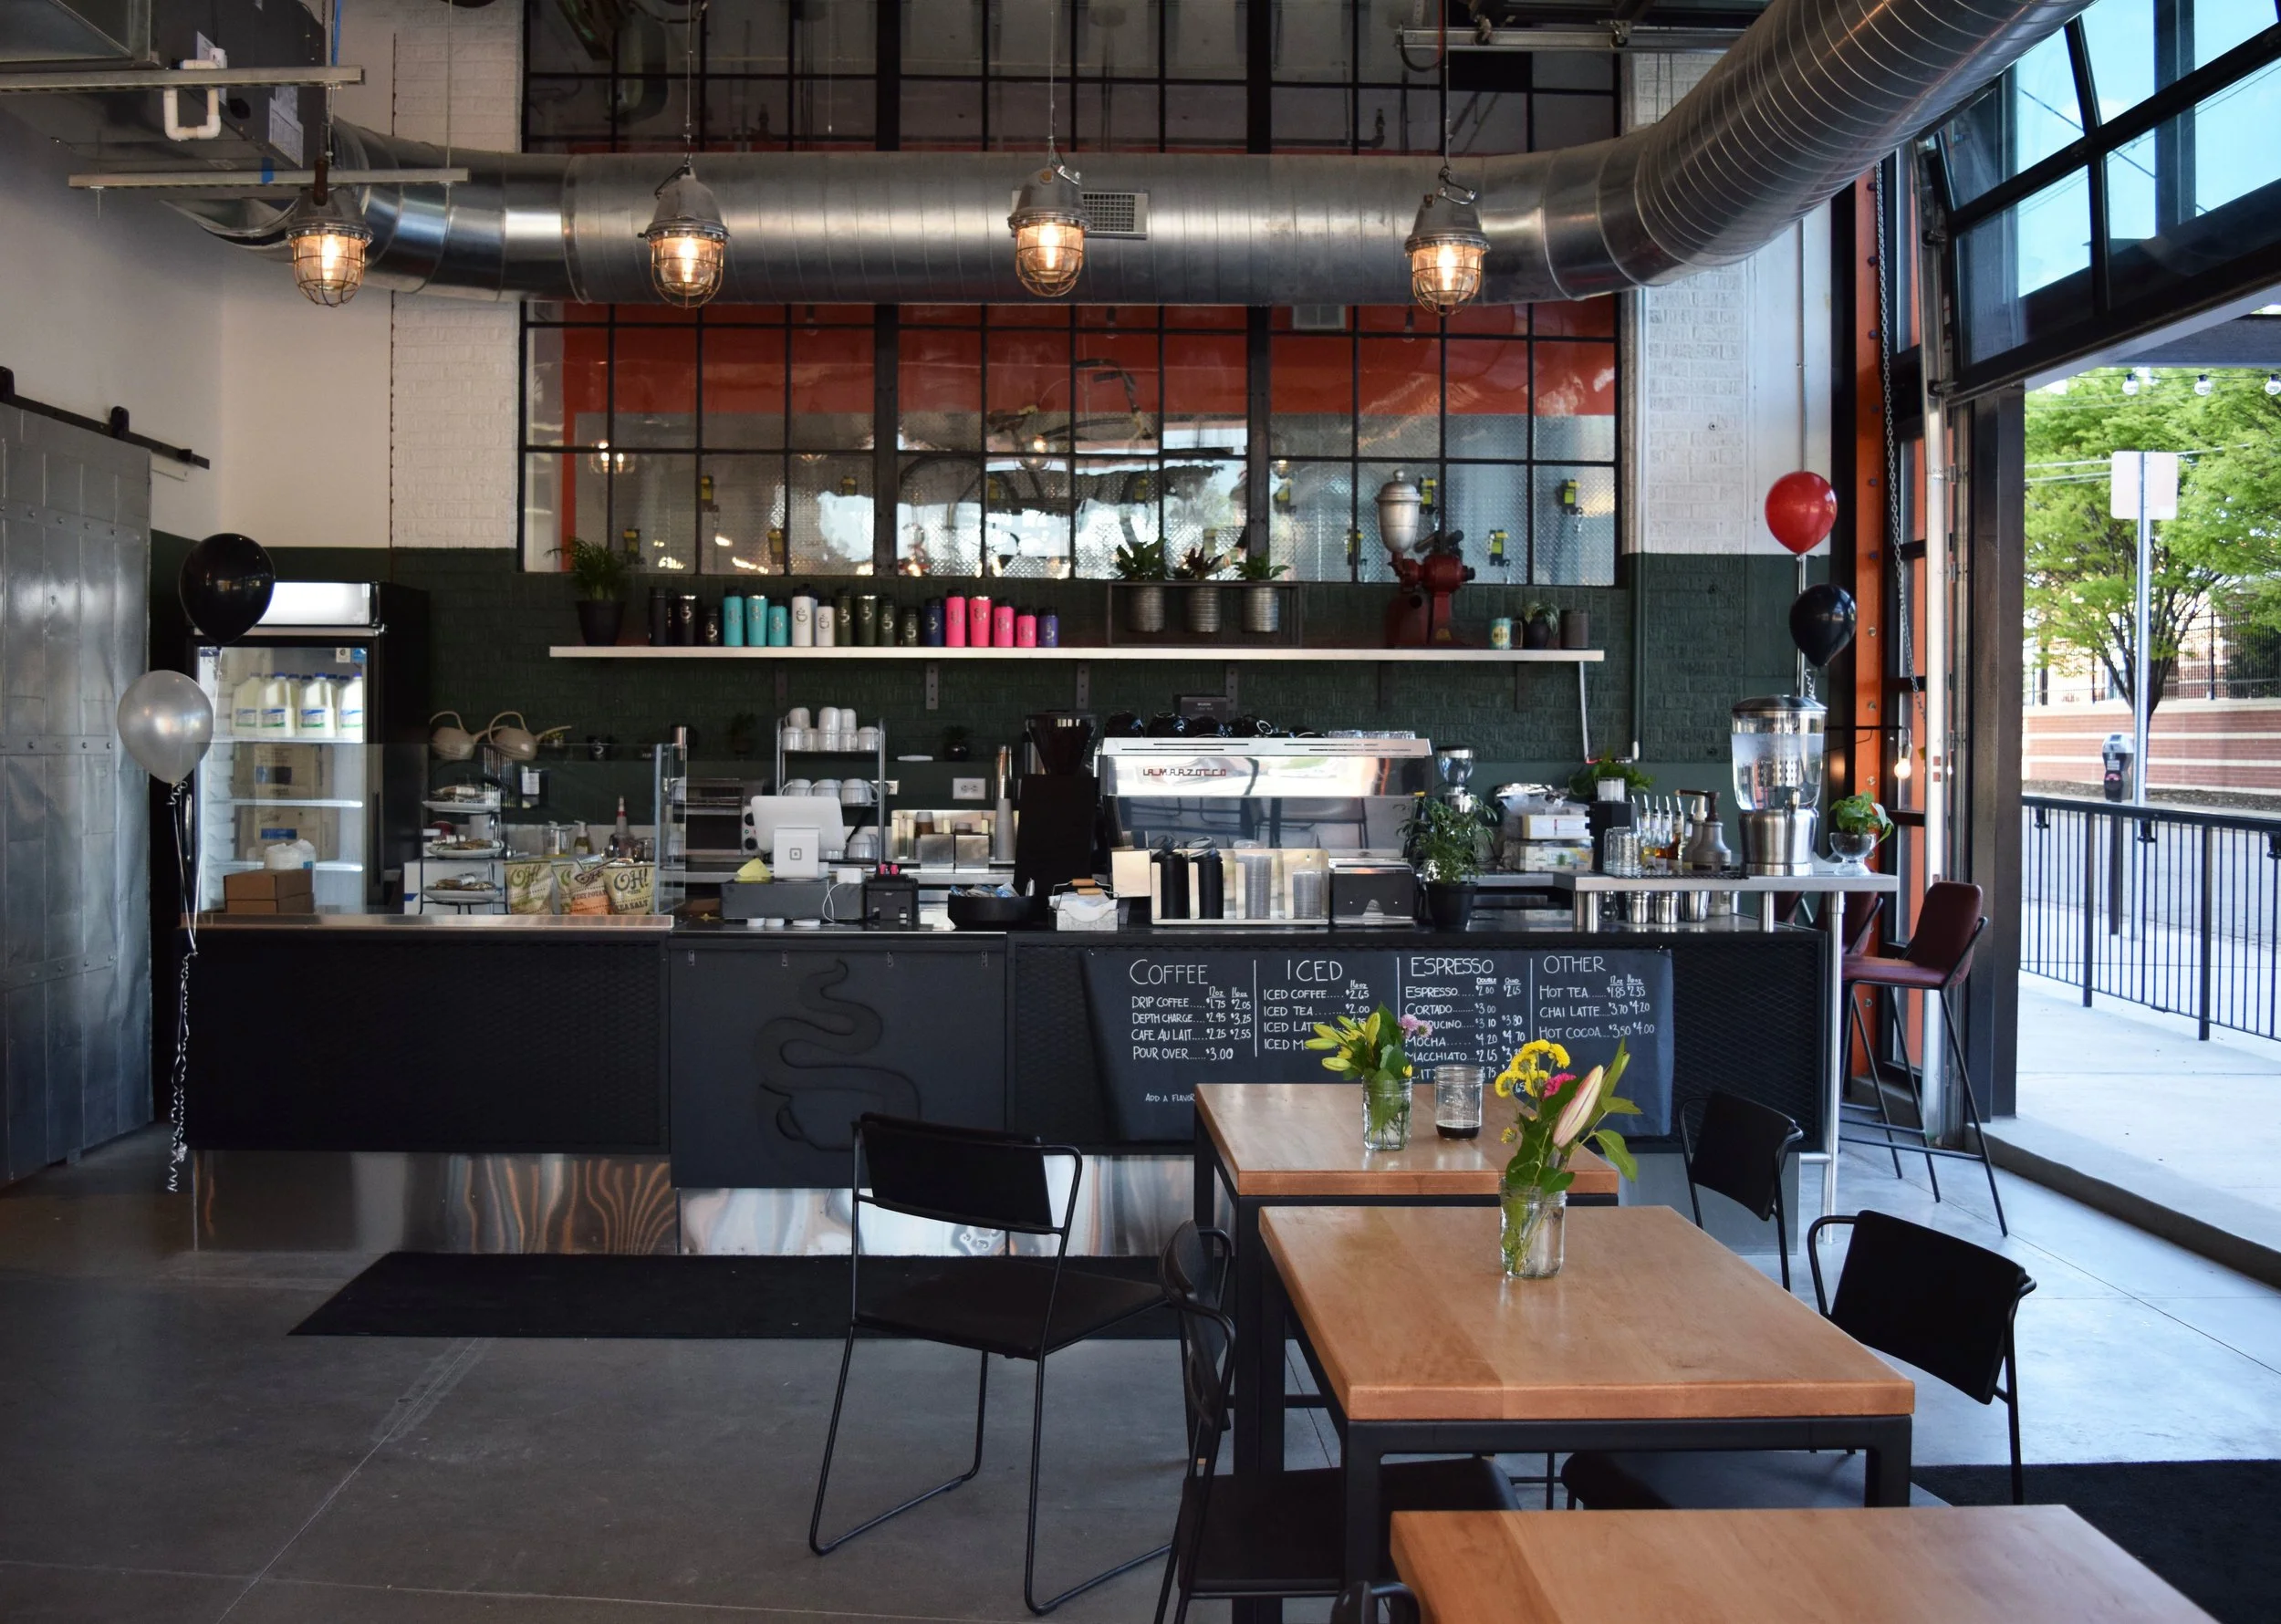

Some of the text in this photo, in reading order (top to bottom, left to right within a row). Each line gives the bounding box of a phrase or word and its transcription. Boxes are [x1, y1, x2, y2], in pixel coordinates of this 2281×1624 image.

[613, 868, 649, 891] OH!
[1411, 957, 1495, 976] ESPRESSO
[1543, 955, 1606, 973] OTHER
[1130, 959, 1208, 984] COFFEE
[1287, 960, 1343, 981] ICED
[1263, 989, 1288, 1000] ICED
[1539, 985, 1564, 1000] HOT
[1131, 996, 1154, 1008] DRIP
[1264, 1006, 1287, 1016] ICED
[1539, 1007, 1565, 1018] CHAI
[1132, 1013, 1160, 1024] DEPTH
[1264, 1021, 1324, 1033] ICED LAT
[1539, 1026, 1562, 1039] HOT
[1131, 1029, 1154, 1040] CAFE
[1157, 1029, 1171, 1041] AU
[1264, 1038, 1289, 1050] ICED
[1133, 1046, 1159, 1059] POUR
[1145, 1093, 1160, 1102] ADD
